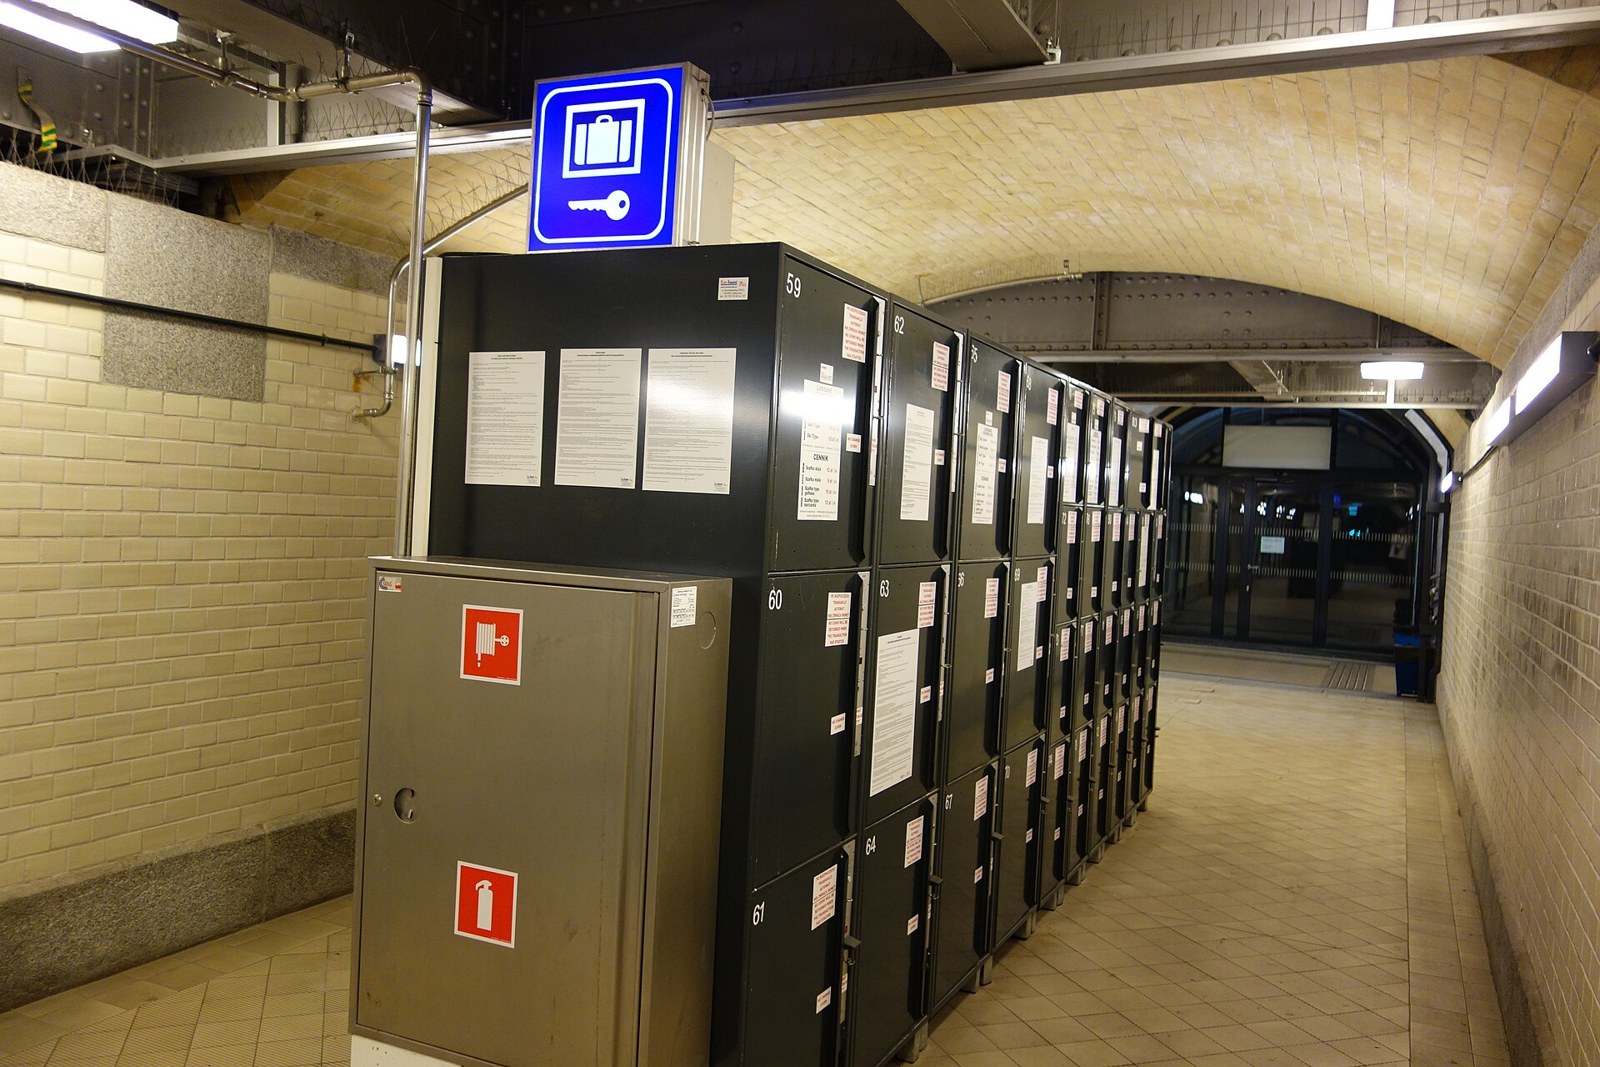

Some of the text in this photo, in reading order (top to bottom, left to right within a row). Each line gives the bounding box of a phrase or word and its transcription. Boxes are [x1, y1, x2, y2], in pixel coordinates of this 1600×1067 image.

[786, 272, 801, 298] 59
[894, 314, 904, 335] 62
[768, 589, 782, 610] 60
[880, 580, 890, 598] 63
[945, 794, 953, 810] 67
[865, 835, 877, 856] 64
[752, 901, 765, 926] 61
